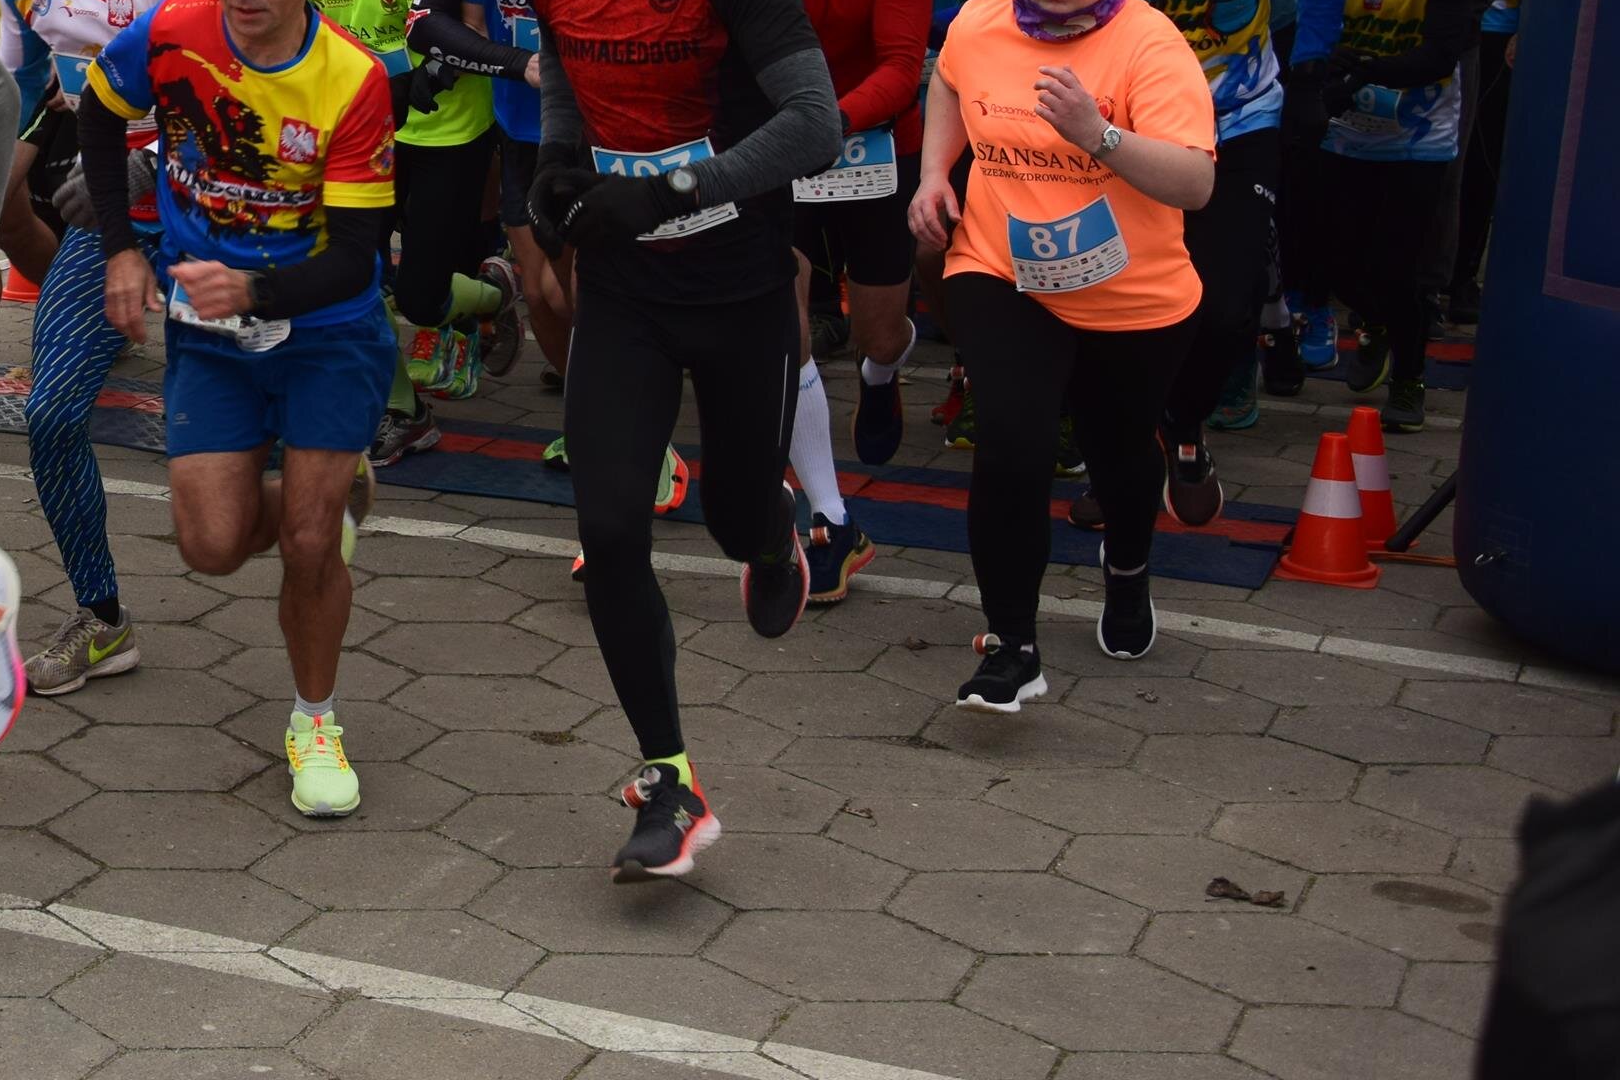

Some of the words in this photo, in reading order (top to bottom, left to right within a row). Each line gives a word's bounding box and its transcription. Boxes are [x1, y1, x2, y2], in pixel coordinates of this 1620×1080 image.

[444, 54, 504, 74] GIANT
[837, 136, 866, 165] 6
[976, 142, 1064, 169] SZANSA
[1066, 154, 1101, 172] NA
[1029, 218, 1081, 258] 87
